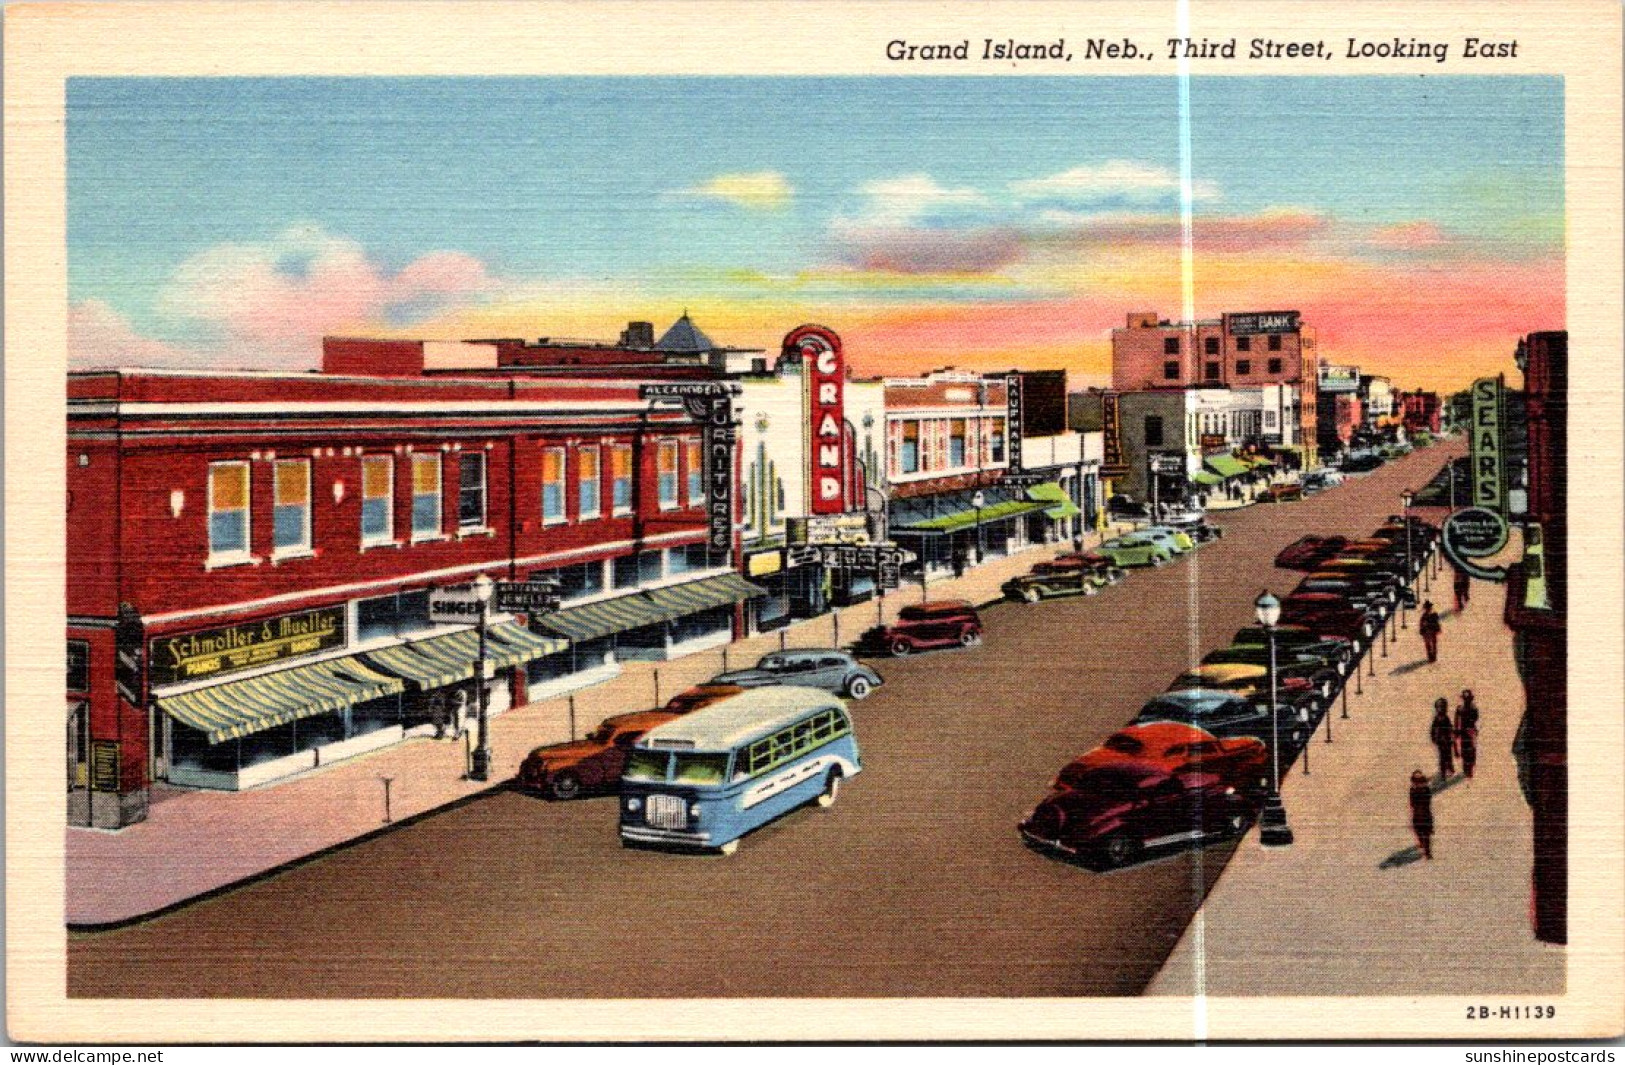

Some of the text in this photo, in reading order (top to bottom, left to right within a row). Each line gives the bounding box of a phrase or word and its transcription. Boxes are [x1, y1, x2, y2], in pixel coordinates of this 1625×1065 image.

[1258, 315, 1290, 328] BANK
[645, 384, 722, 396] ALEXANDER
[816, 349, 841, 501] GRAND
[1477, 381, 1496, 501] SEARS
[432, 600, 486, 615] SINGER
[167, 627, 254, 669] Schmoller
[279, 612, 336, 637] Mueller
[1466, 1005, 1556, 1020] 2B-H1139
